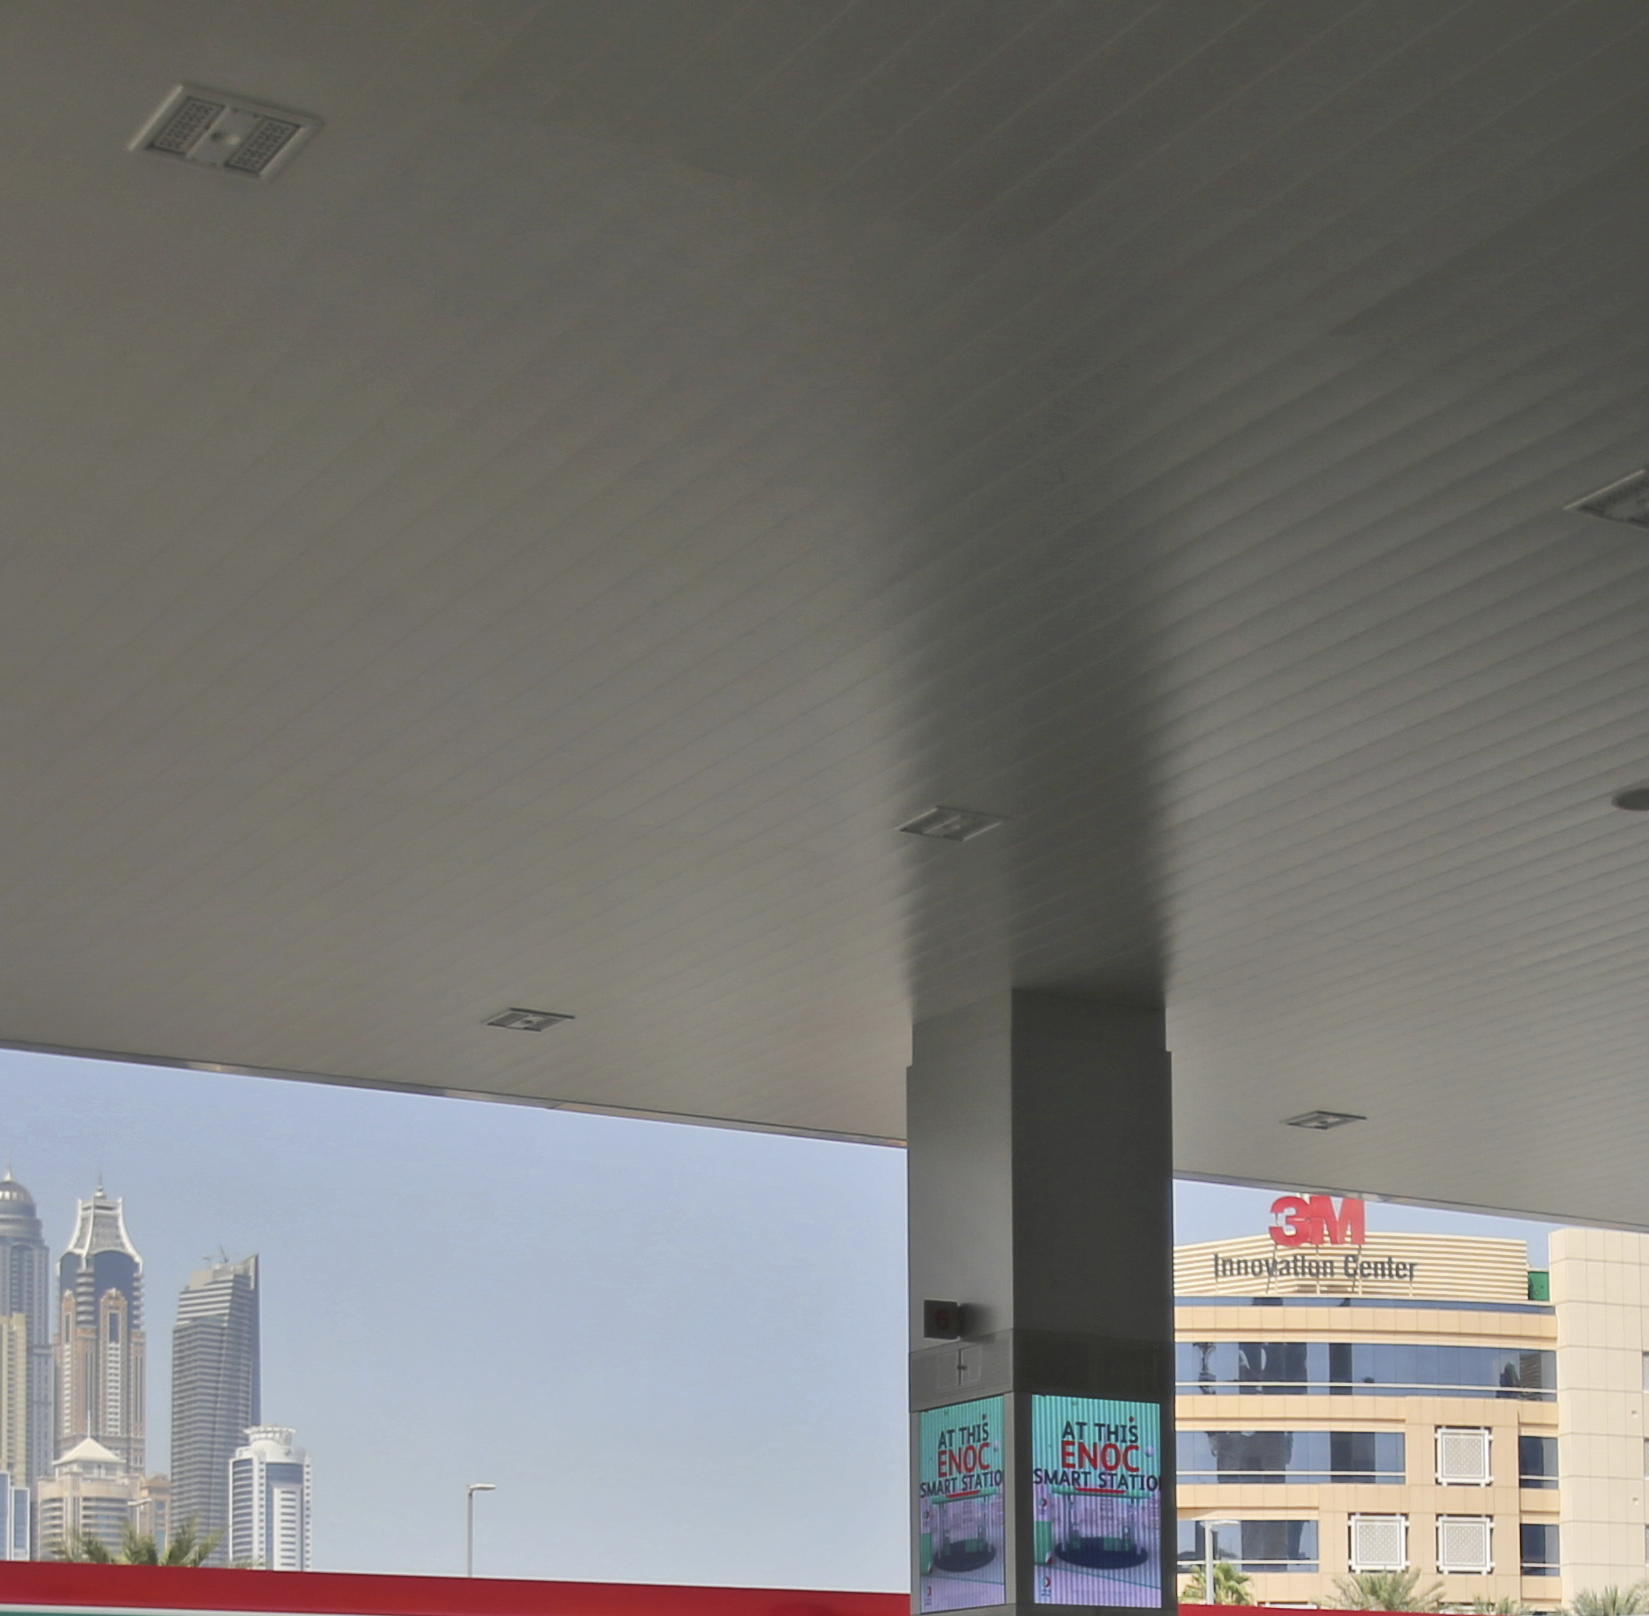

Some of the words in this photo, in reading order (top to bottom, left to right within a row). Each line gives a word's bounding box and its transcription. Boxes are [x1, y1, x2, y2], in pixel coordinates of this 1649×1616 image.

[1269, 1195, 1366, 1248] 3M
[1213, 1253, 1335, 1278] Innovation
[1343, 1254, 1417, 1280] Center
[937, 1429, 955, 1450] AT
[959, 1422, 990, 1445] THIS
[1062, 1421, 1088, 1441] AT
[1094, 1423, 1139, 1445] THIS
[937, 1442, 990, 1479] ENOC
[1060, 1440, 1140, 1473] ENOC
[920, 1477, 957, 1499] SMART
[1033, 1467, 1092, 1489] SMART
[1098, 1471, 1161, 1492] STATIO
